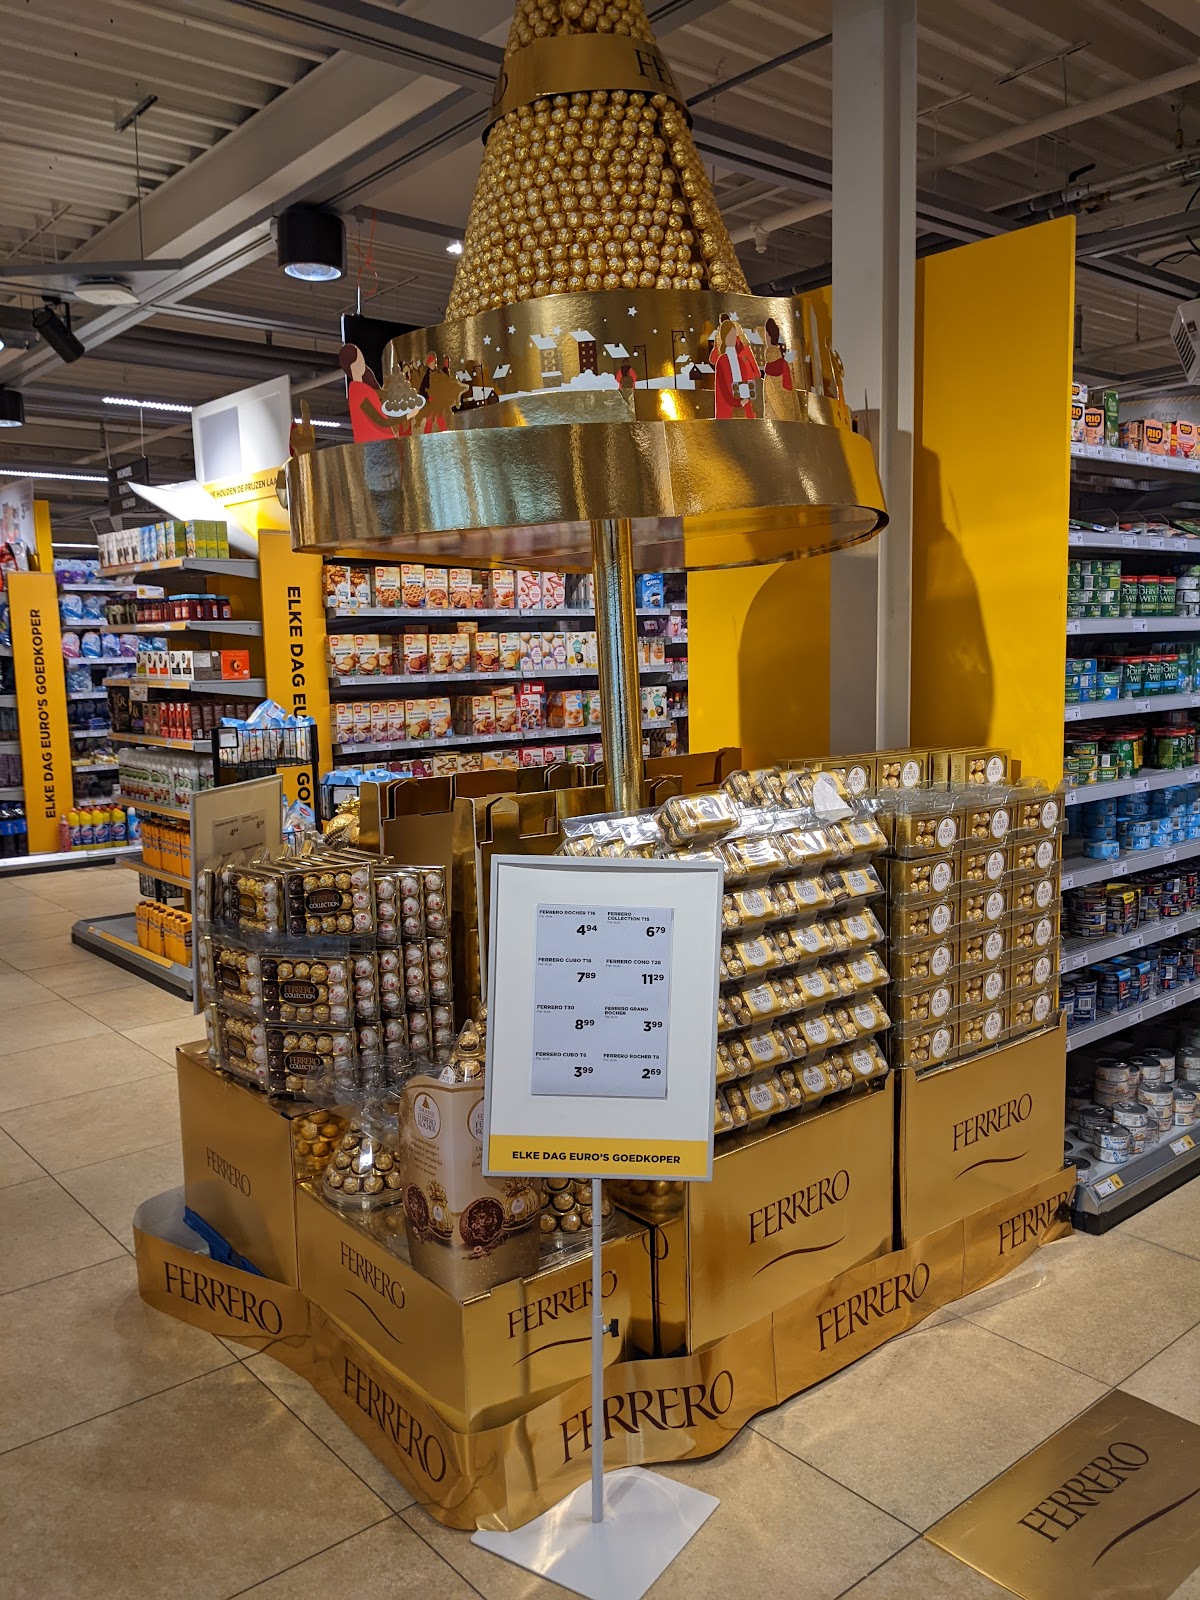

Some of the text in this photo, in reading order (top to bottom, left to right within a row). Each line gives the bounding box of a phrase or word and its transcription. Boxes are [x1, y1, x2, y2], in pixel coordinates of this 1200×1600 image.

[1086, 415, 1100, 423] RIO
[1147, 429, 1161, 438] RIO
[217, 488, 237, 498] HOUDEN
[245, 480, 266, 491] PRIJZEN
[266, 478, 278, 488] LAA
[288, 586, 303, 637] ELKE
[290, 644, 305, 688] DAG
[30, 609, 56, 818] ELKE DAG EURO'S GOEDKOPER
[230, 828, 239, 836] 494
[284, 985, 315, 993] FERRERO
[290, 1057, 320, 1066] FERRERO
[952, 1094, 1033, 1152] FERRERO
[207, 1147, 251, 1196] FERRERO
[512, 1151, 681, 1164] ELKE DAG EURO'S GOEDKOPER
[748, 1170, 850, 1245] FERRERO
[164, 1261, 283, 1335] FERRERO
[340, 1240, 406, 1309] FERRERO
[817, 1263, 930, 1352] FERRERO
[343, 1356, 447, 1482] FERRERO
[1017, 1442, 1149, 1543] FERRERO
